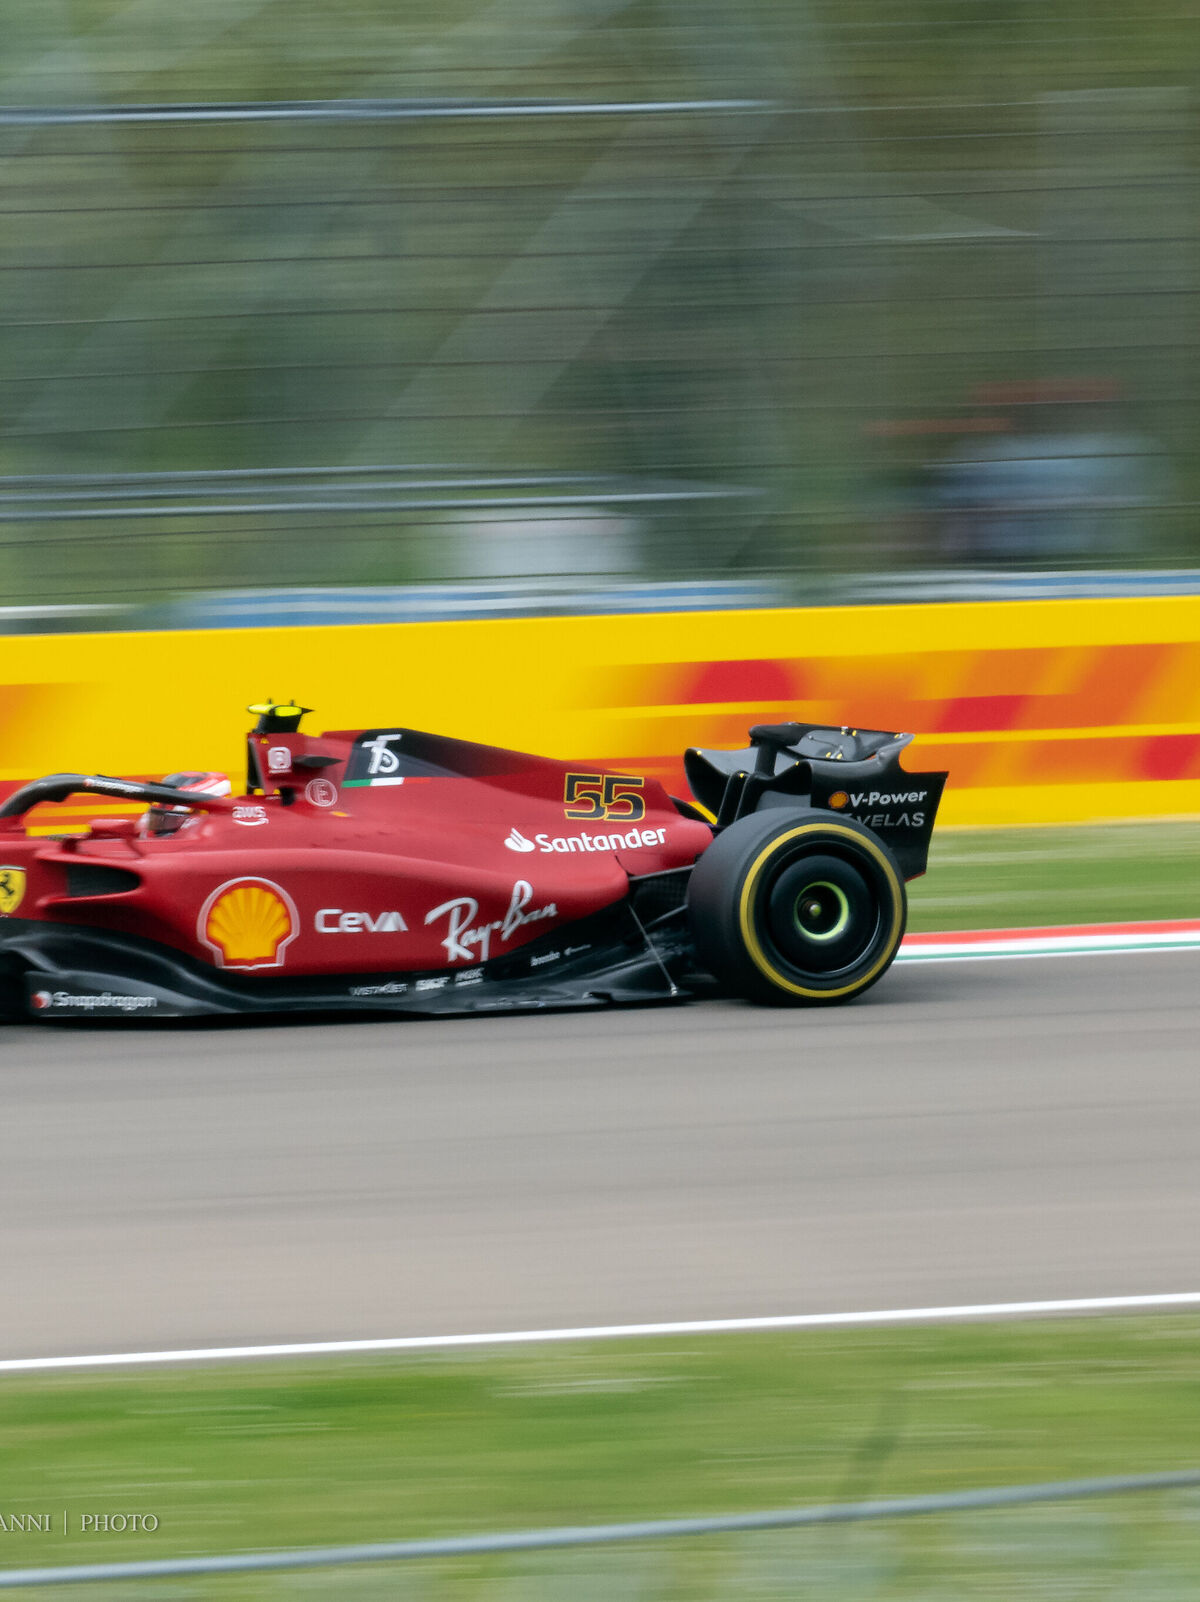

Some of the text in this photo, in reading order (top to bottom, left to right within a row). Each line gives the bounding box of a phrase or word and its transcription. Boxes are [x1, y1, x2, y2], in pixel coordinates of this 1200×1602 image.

[564, 772, 646, 822] 55
[850, 790, 928, 807] V-Power
[535, 828, 667, 853] Santander
[52, 991, 157, 1011] Snapdragon
